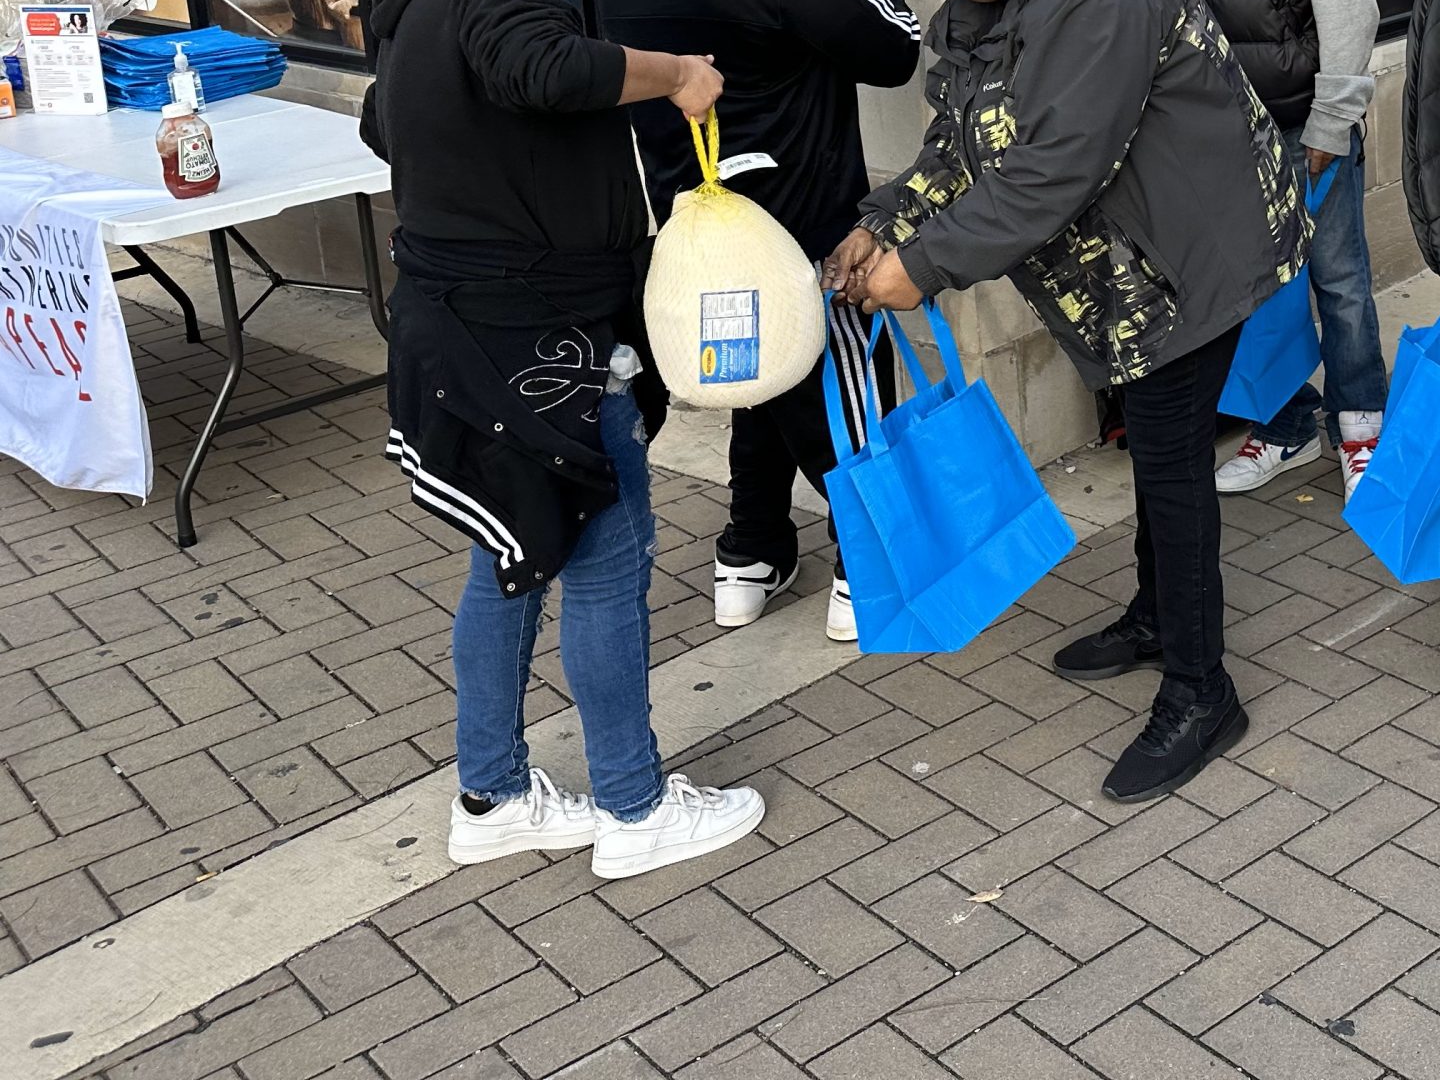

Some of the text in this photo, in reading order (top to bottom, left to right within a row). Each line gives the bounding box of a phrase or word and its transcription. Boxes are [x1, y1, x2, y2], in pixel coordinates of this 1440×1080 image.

[185, 157, 211, 170] TOMATO
[191, 167, 211, 177] HEINZ
[0, 223, 85, 270] UNITIES
